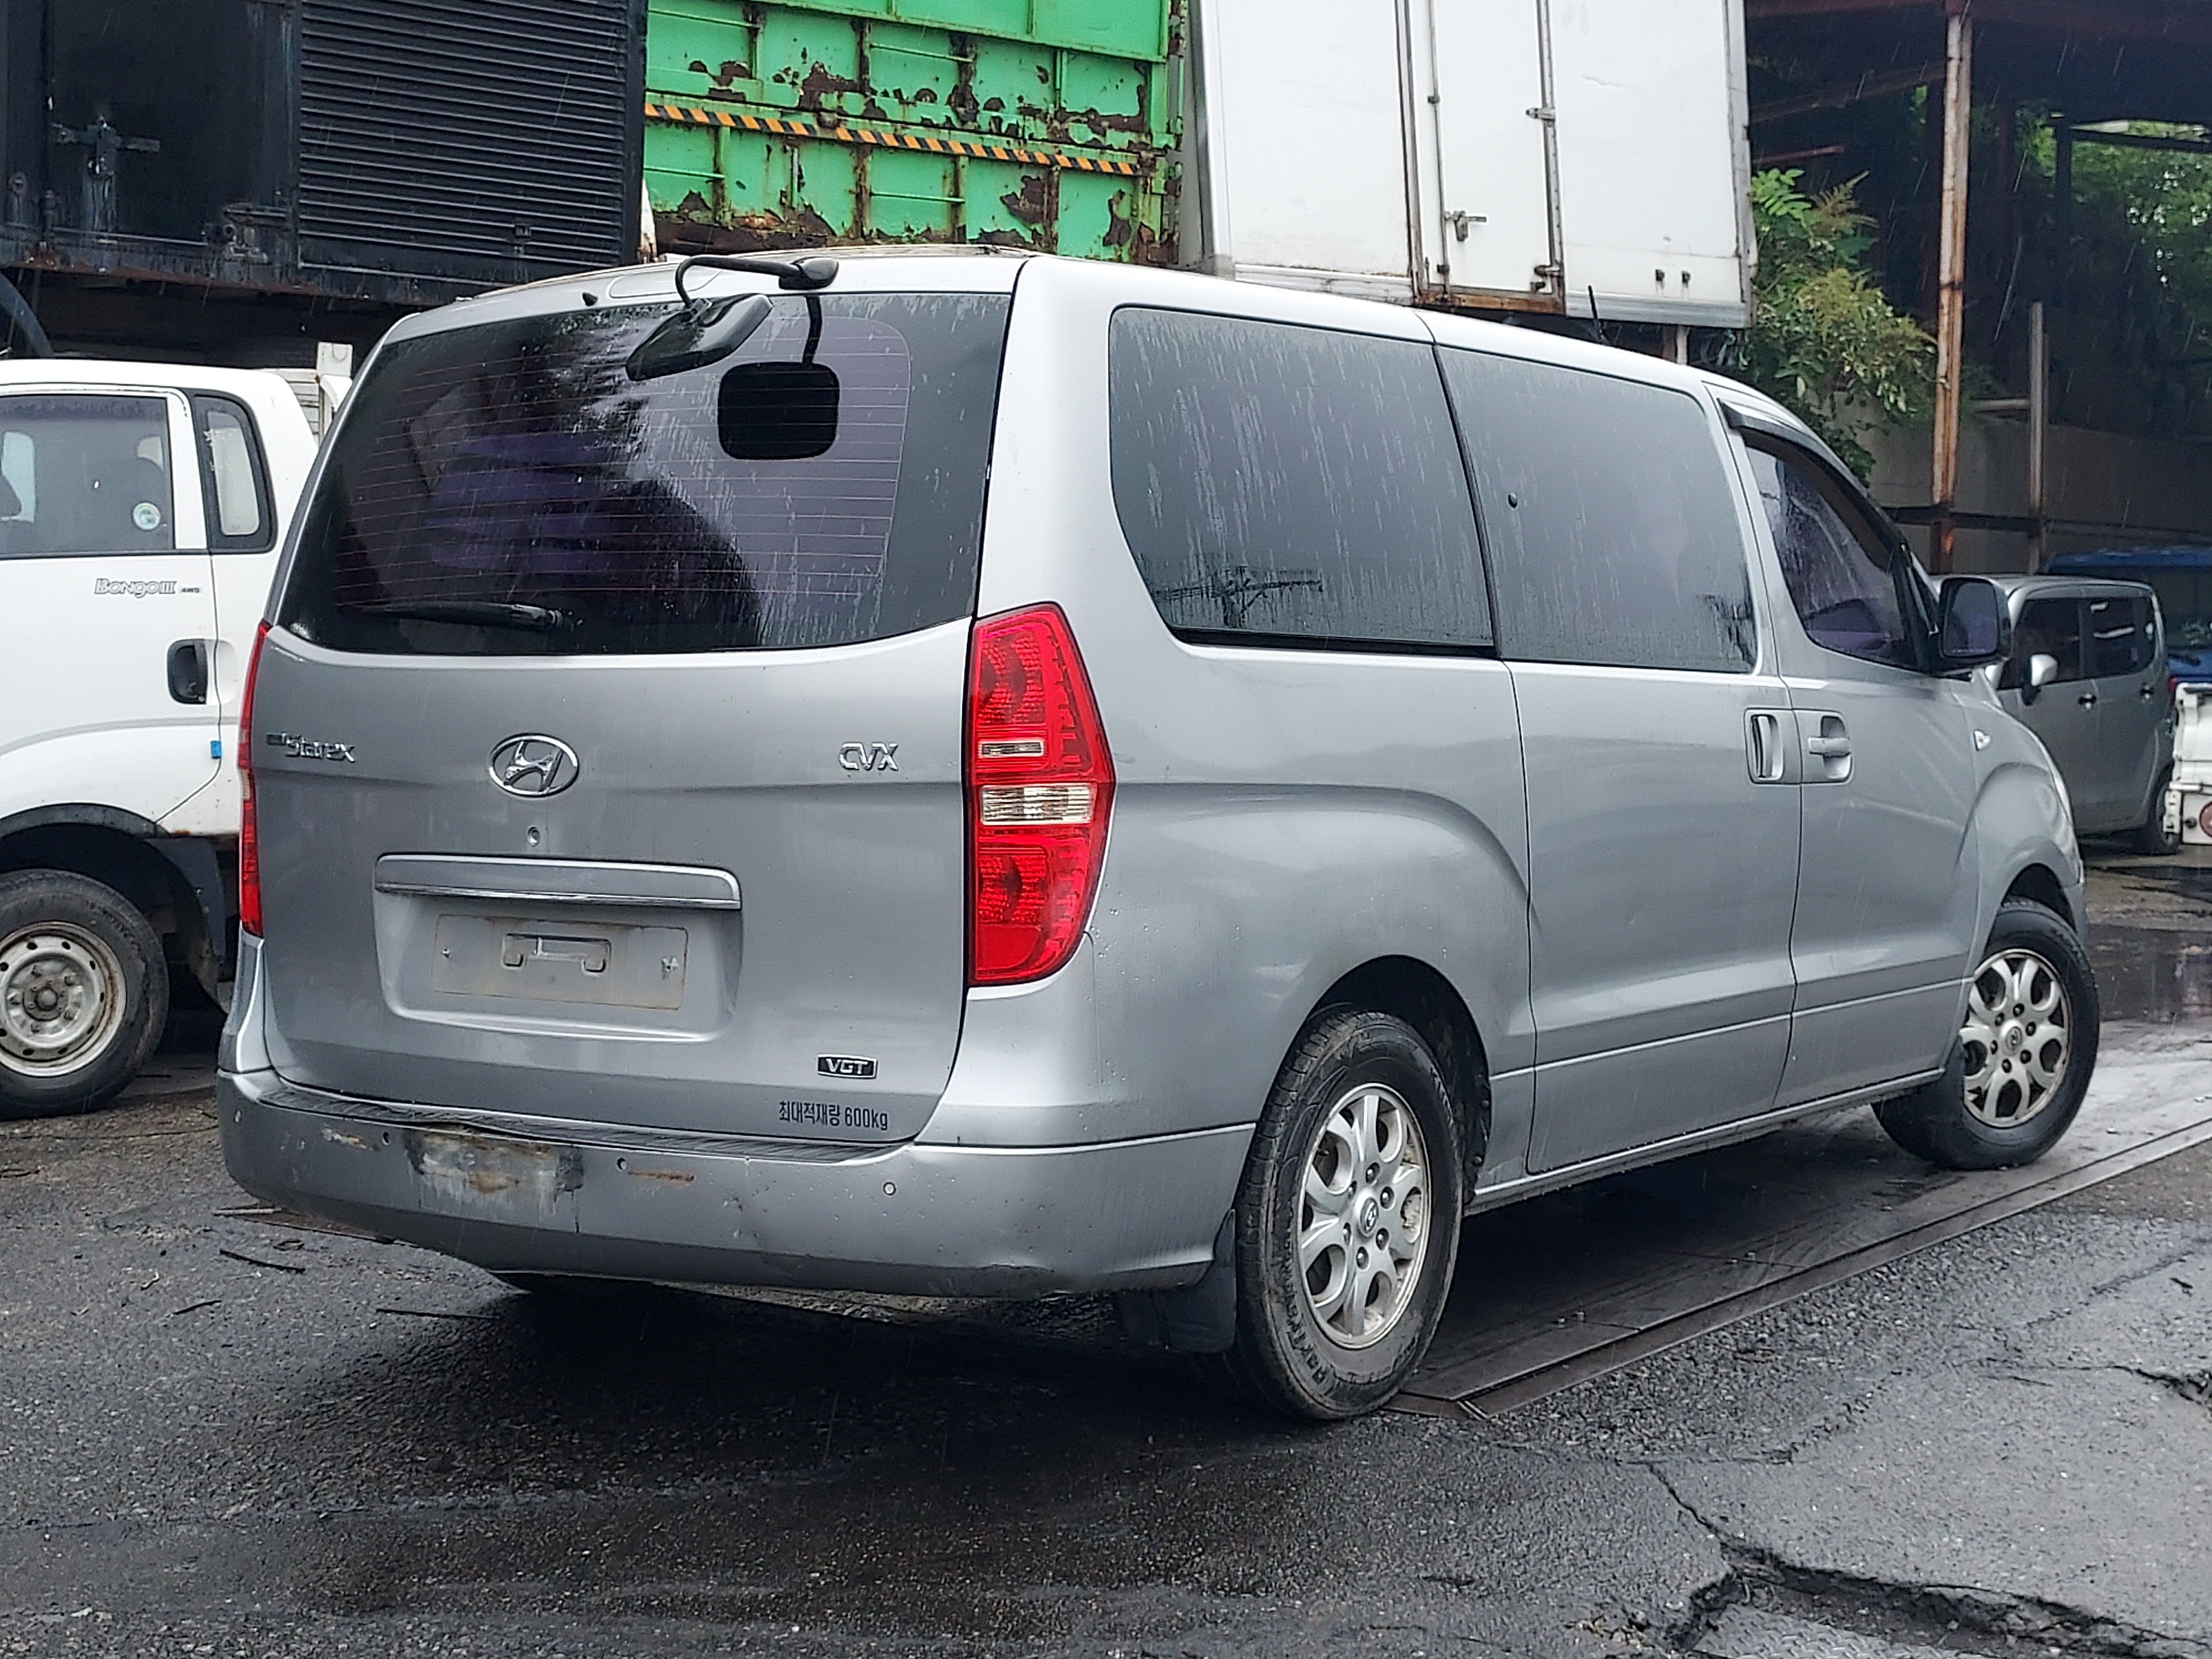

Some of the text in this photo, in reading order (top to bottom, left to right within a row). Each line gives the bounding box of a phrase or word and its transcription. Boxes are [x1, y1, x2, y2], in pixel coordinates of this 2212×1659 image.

[839, 742, 899, 771] CVX
[826, 1058, 869, 1074] VGT
[779, 1101, 888, 1131] 최대적재량 600kg
